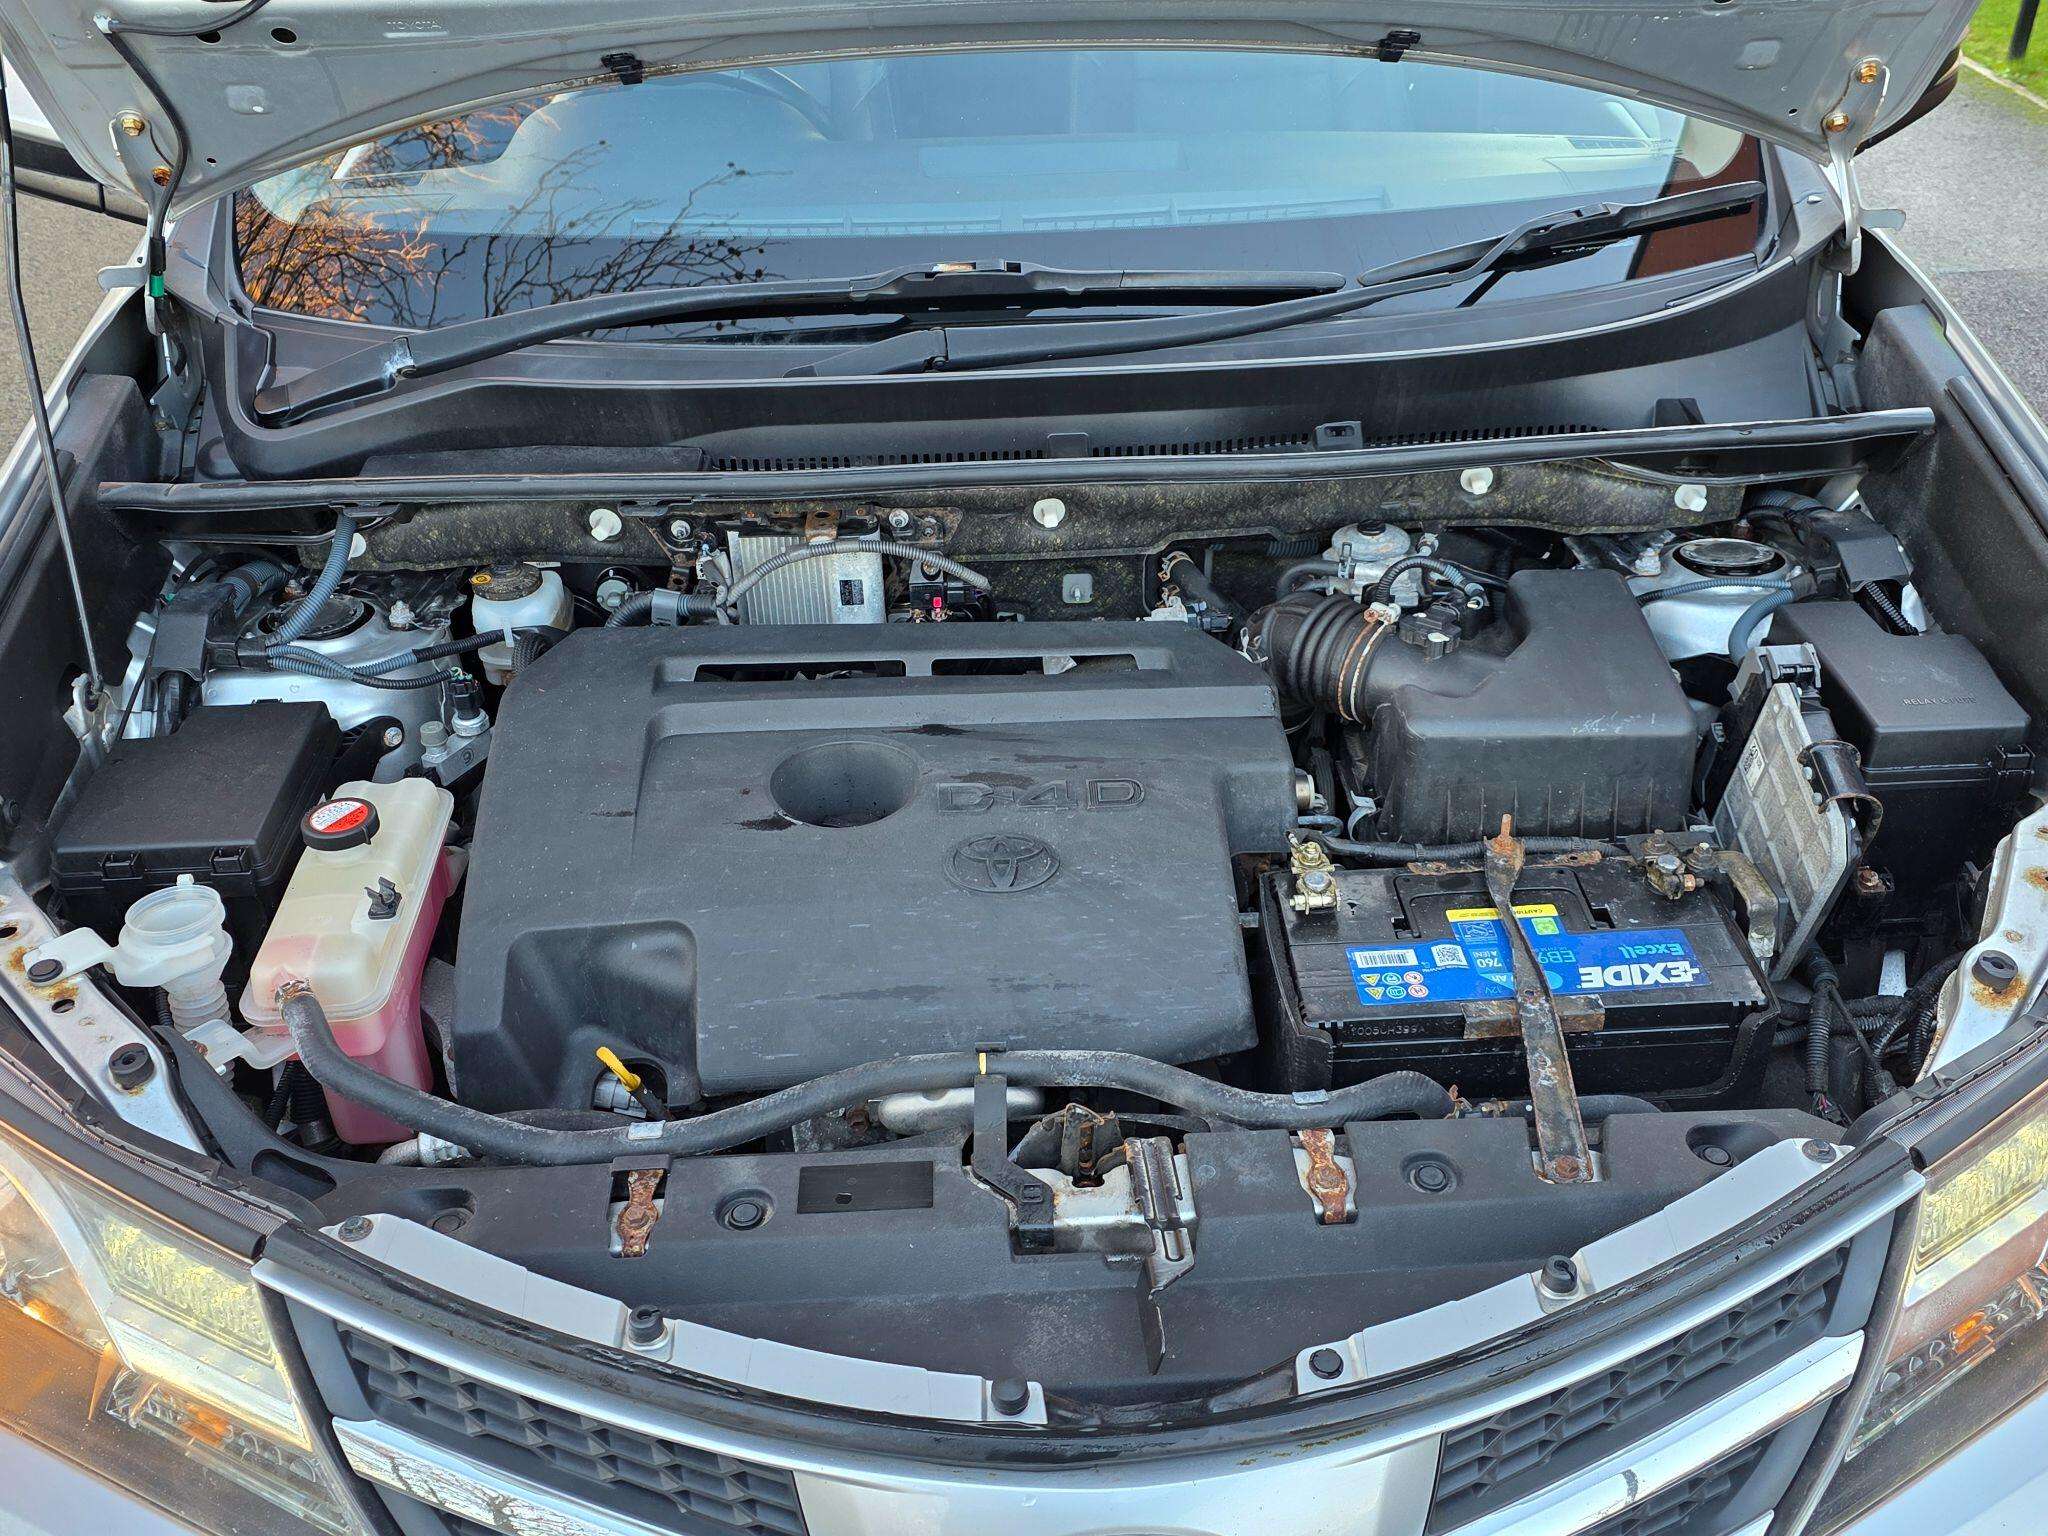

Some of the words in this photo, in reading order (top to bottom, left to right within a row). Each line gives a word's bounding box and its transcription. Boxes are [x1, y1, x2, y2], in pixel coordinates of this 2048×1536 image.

[385, 20, 442, 30] TOYOTA
[1537, 950, 1577, 964] EB9
[1618, 943, 1685, 959] Excell
[1476, 957, 1502, 968] 760
[1579, 961, 1700, 988] EXIDE
